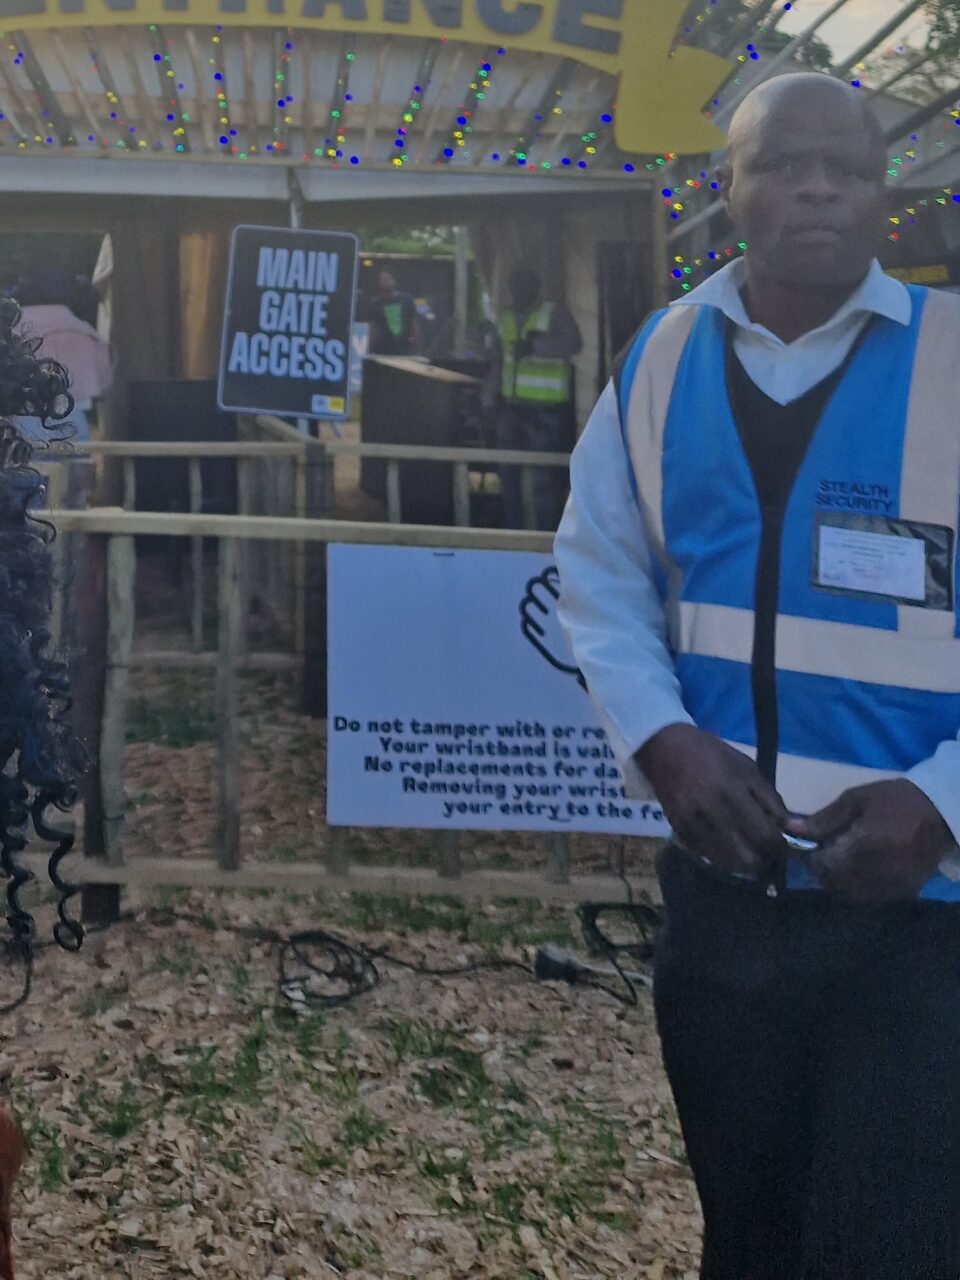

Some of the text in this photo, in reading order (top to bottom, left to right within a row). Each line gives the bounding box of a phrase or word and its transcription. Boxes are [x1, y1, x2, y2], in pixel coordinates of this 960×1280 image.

[256, 246, 338, 293] MAIN
[259, 290, 329, 336] GATE
[228, 331, 345, 382] ACCESS
[820, 479, 889, 497] STEALTH
[815, 493, 893, 510] SECURITY
[333, 716, 361, 732] Do
[367, 718, 404, 734] not
[410, 718, 489, 739] tamper
[496, 720, 546, 738] with
[552, 725, 575, 739] or
[379, 736, 429, 753] Your
[436, 738, 546, 758] wristband
[553, 740, 571, 758] is
[364, 755, 393, 772] No
[399, 758, 547, 778] replacements
[554, 760, 588, 777] for
[402, 776, 506, 800] Removing
[512, 783, 562, 800] your
[442, 801, 492, 818] your
[499, 800, 560, 820] entry
[566, 801, 589, 816] to
[596, 802, 633, 819] the
